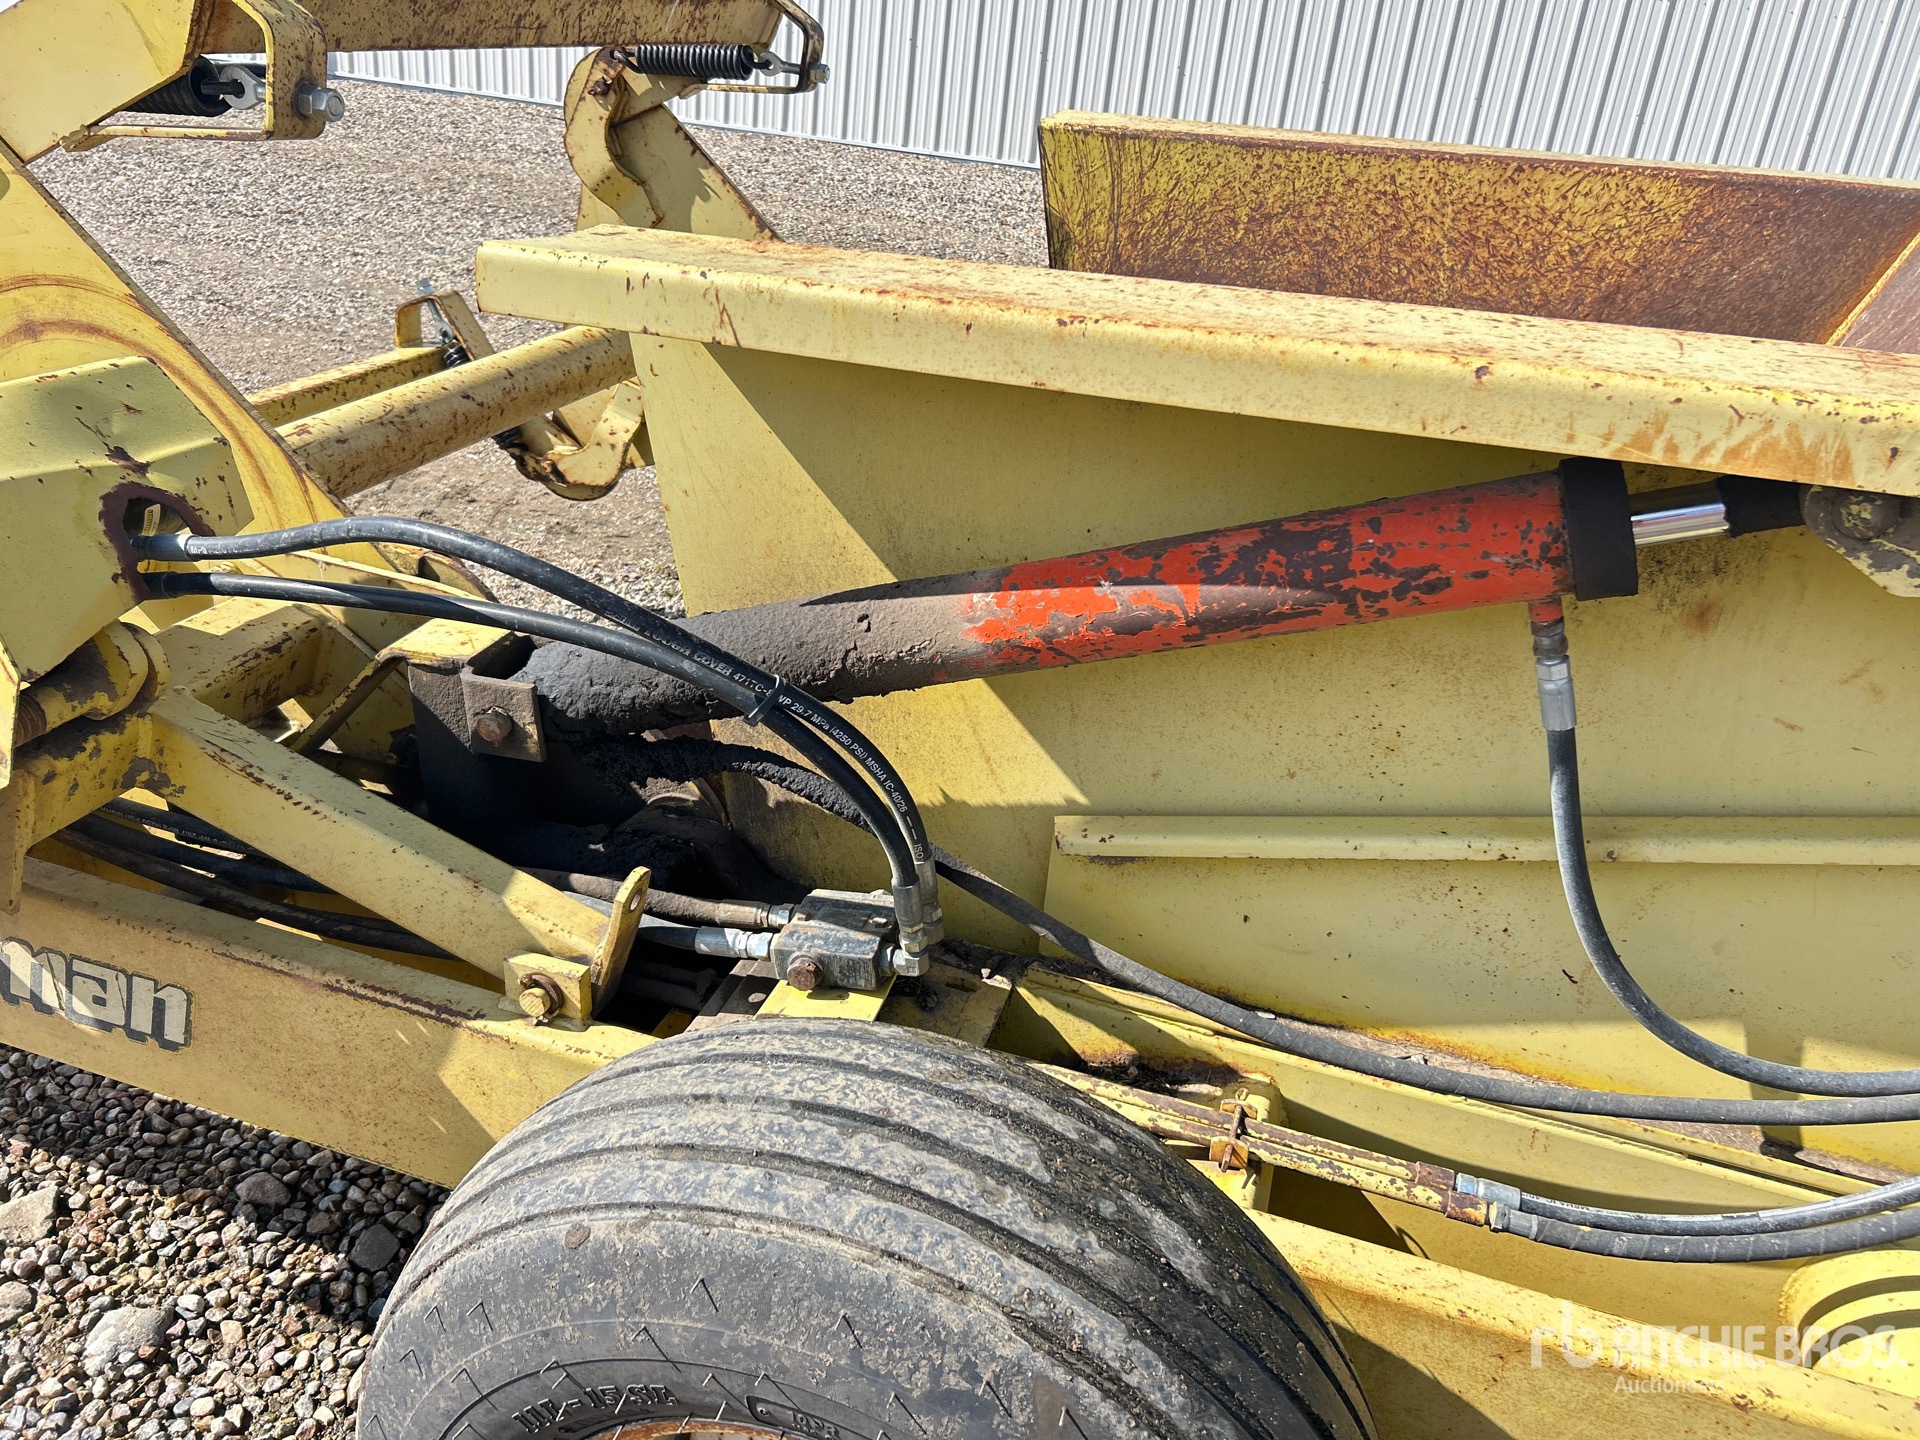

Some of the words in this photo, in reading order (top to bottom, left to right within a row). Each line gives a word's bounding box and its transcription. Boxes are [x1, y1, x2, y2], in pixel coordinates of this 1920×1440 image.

[693, 651, 735, 677] COVER
[790, 702, 813, 718] 29.7
[810, 713, 831, 731] MPa
[828, 725, 853, 746] (4250
[849, 742, 869, 760] PSI)
[864, 757, 888, 782] MSHA
[883, 779, 908, 813] IC-40/26
[913, 843, 925, 859] ISO
